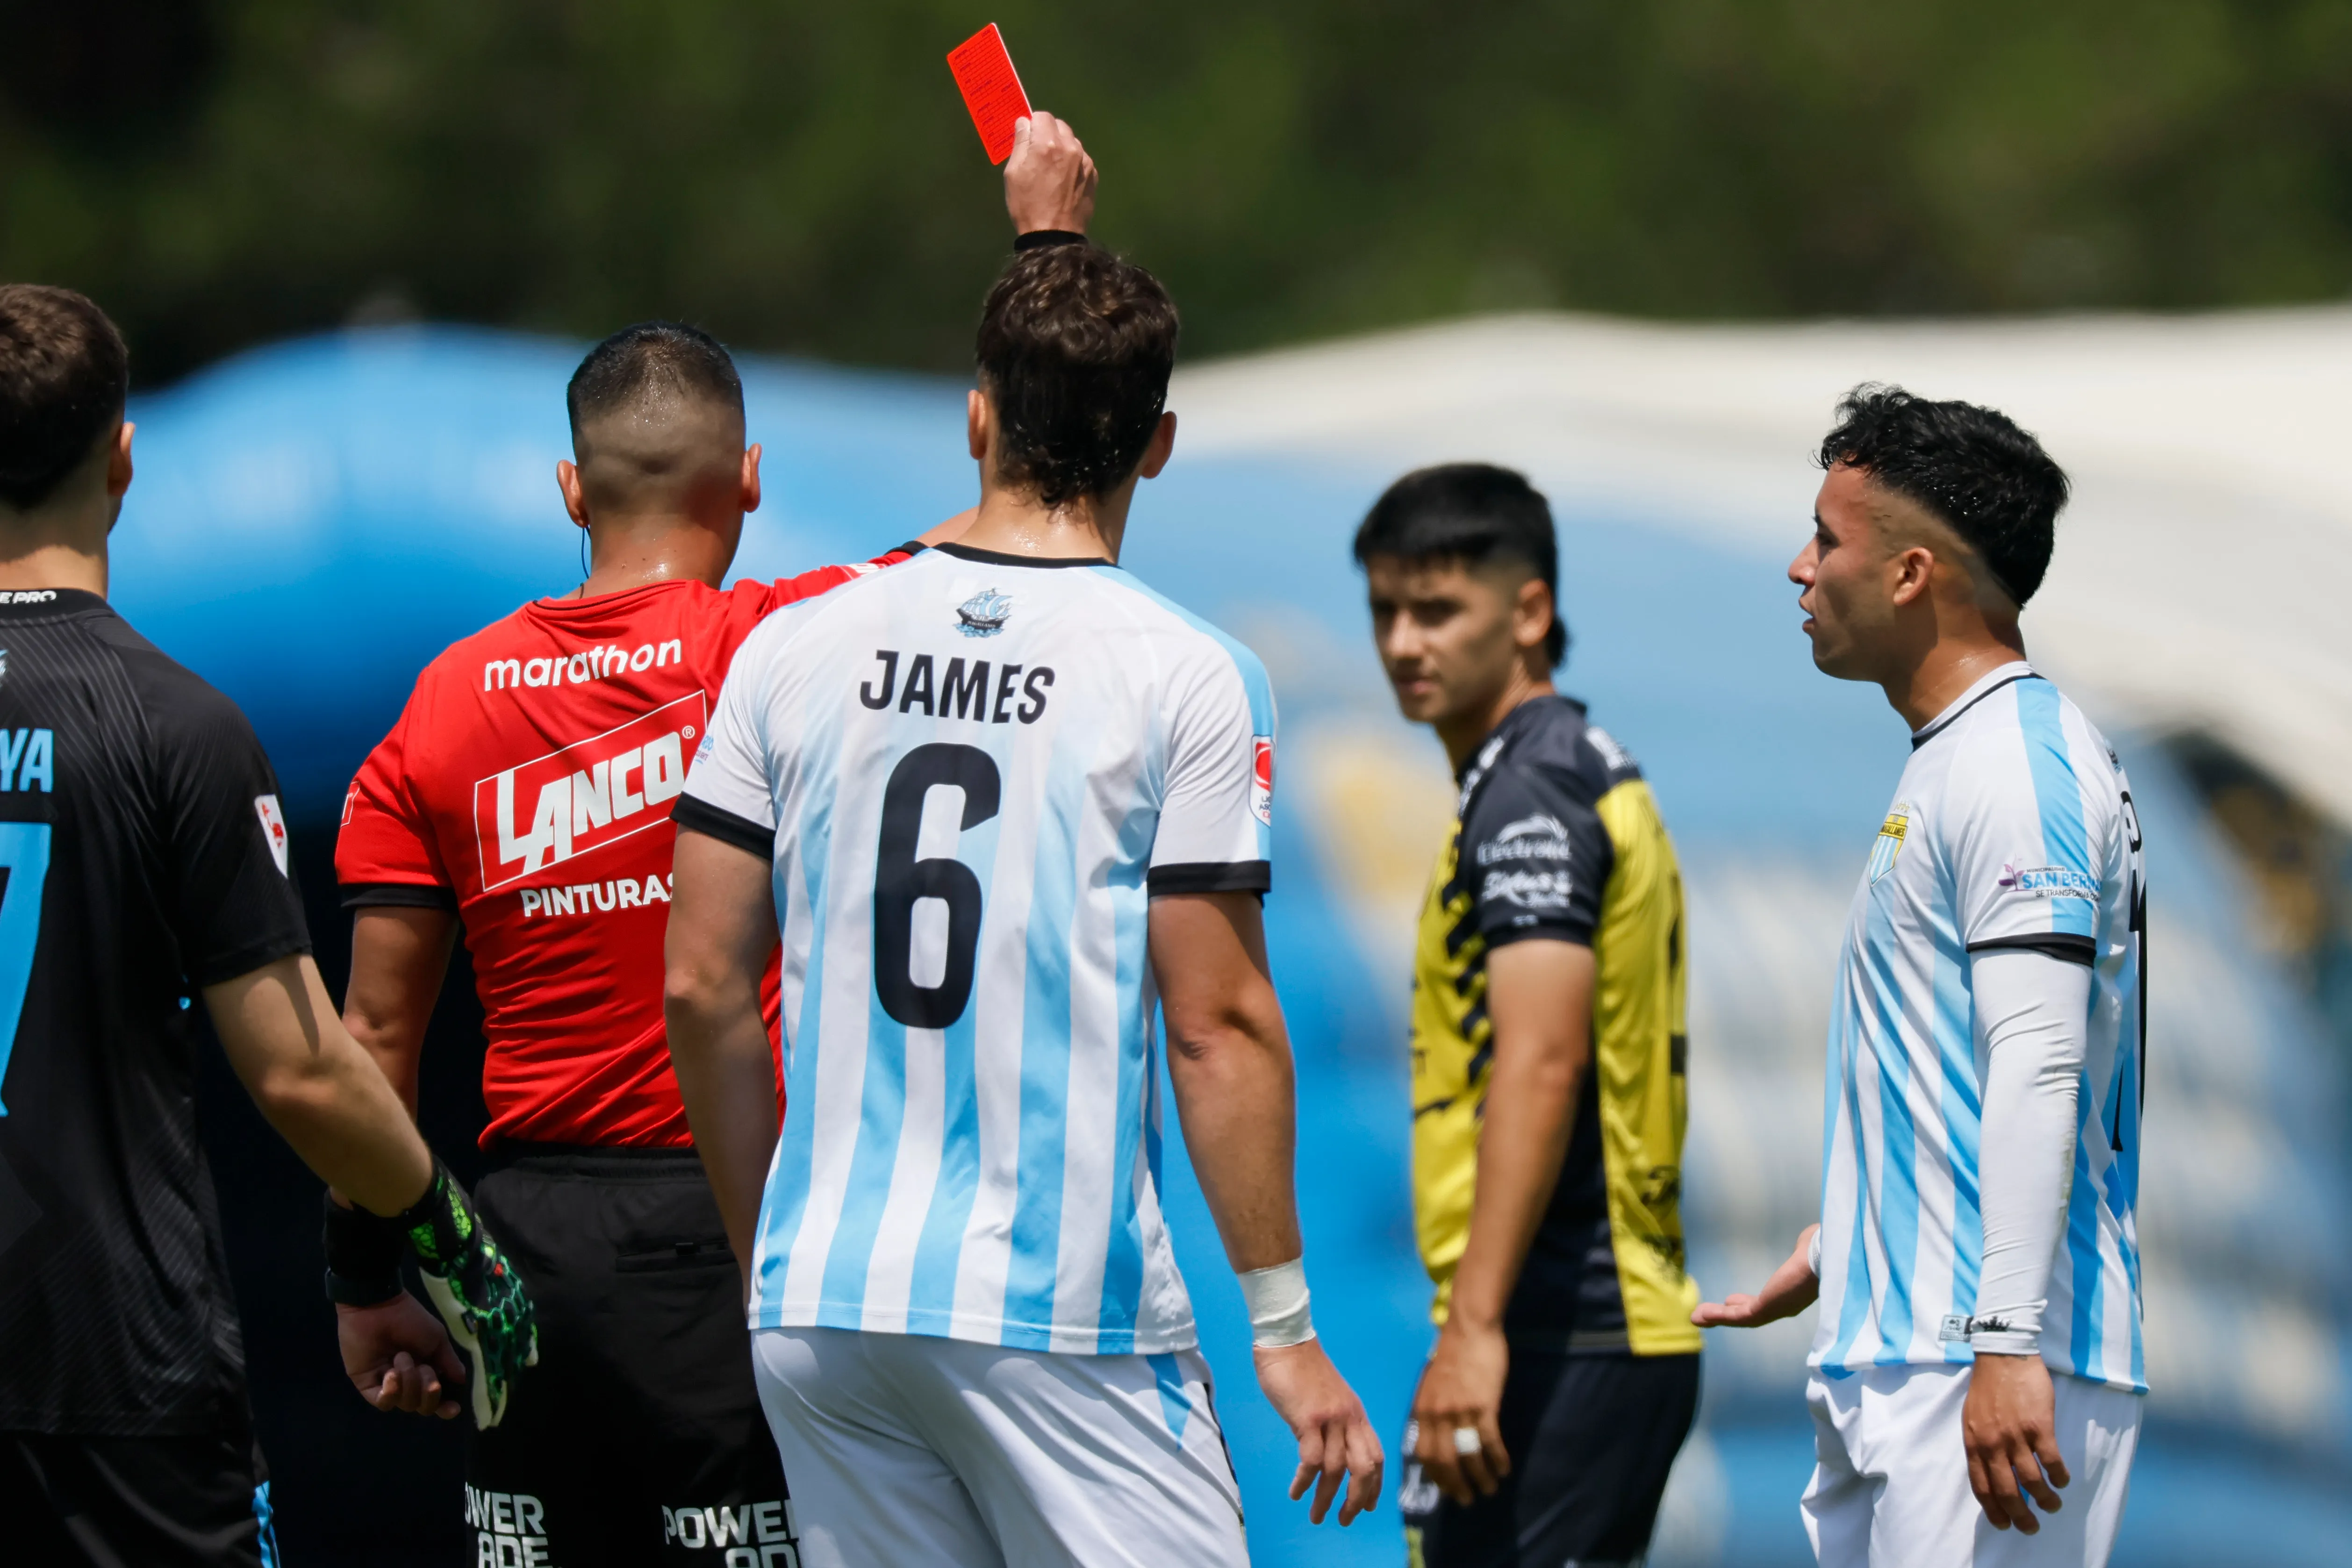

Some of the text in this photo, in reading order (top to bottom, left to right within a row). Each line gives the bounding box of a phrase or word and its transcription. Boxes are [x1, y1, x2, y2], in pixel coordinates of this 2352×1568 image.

[13, 590, 57, 604] PRO
[485, 638, 681, 691] marathon
[860, 649, 1055, 724] JAMES
[0, 727, 53, 793] YA
[498, 731, 685, 874] LANCO
[874, 743, 1001, 1029] 6
[2022, 872, 2057, 889] SAN
[478, 1531, 552, 1568] ADE
